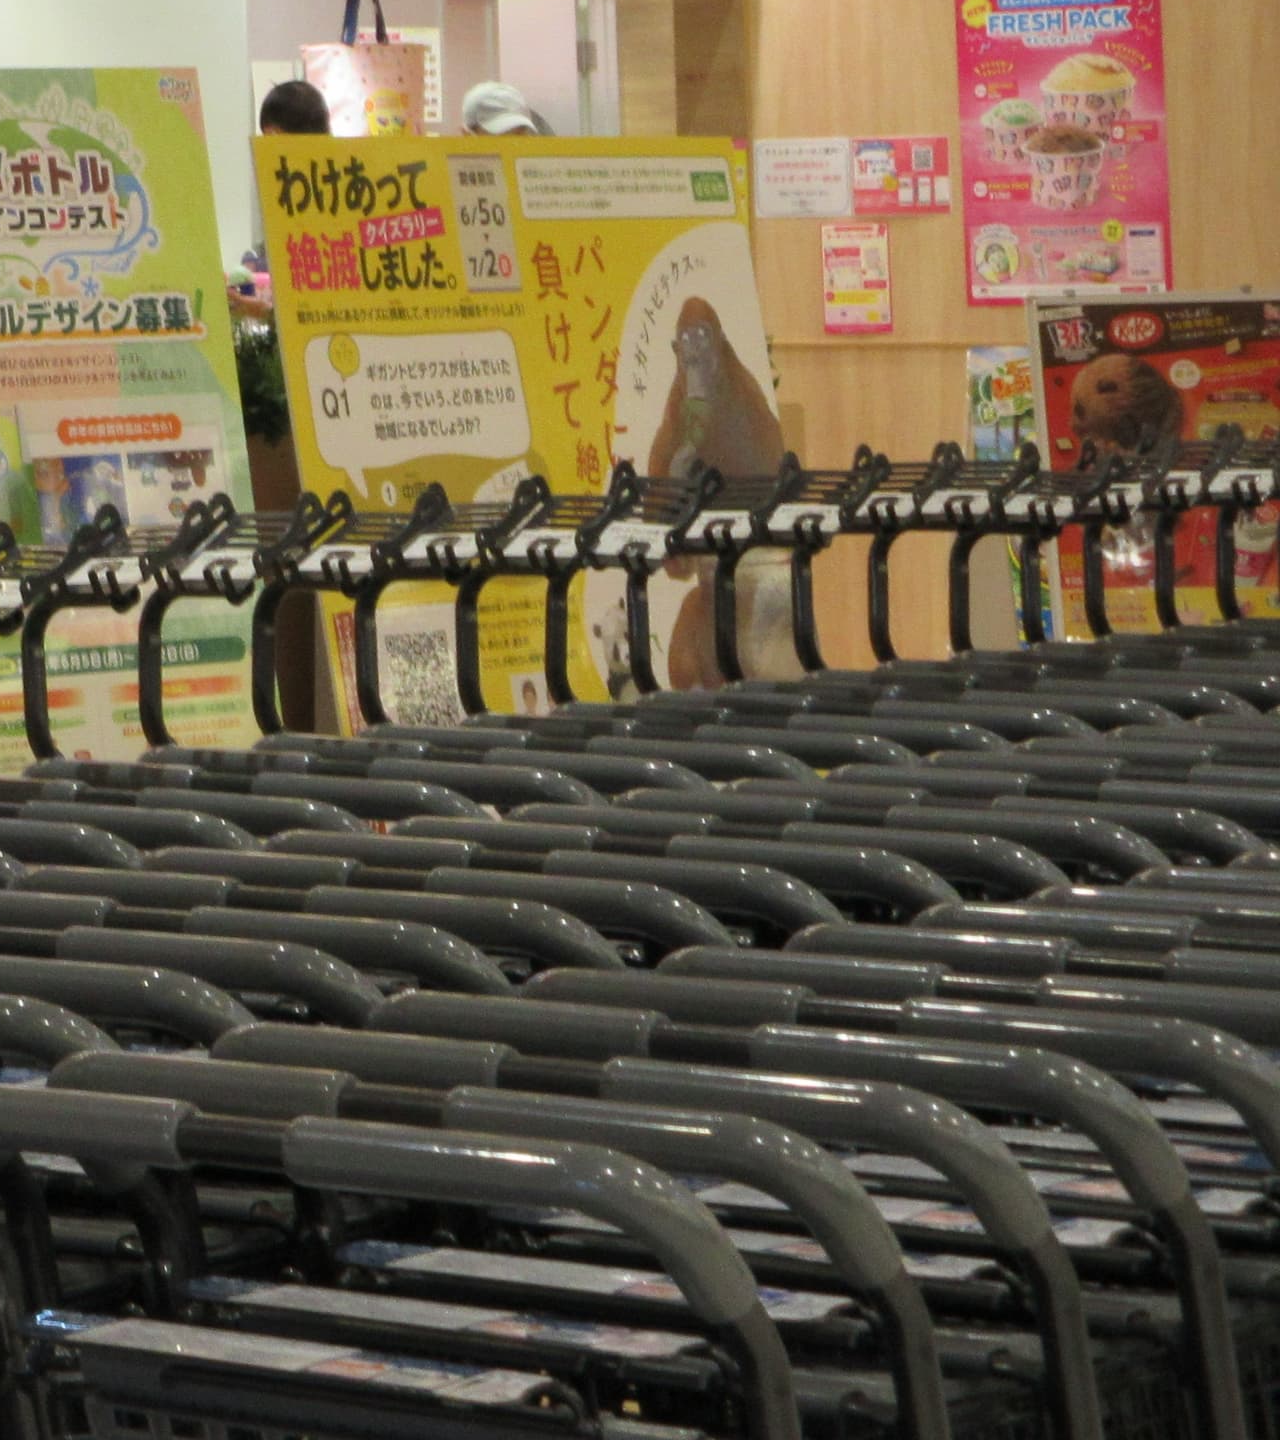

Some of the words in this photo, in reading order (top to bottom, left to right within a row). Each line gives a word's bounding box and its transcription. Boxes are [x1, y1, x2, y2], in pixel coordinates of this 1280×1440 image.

[988, 12, 1062, 34] FRESH
[1068, 7, 1130, 31] PACK
[275, 155, 428, 217] わけあって
[363, 213, 442, 246] クイズラリー
[285, 232, 457, 292] 絶滅しました。
[321, 386, 351, 419] Q1
